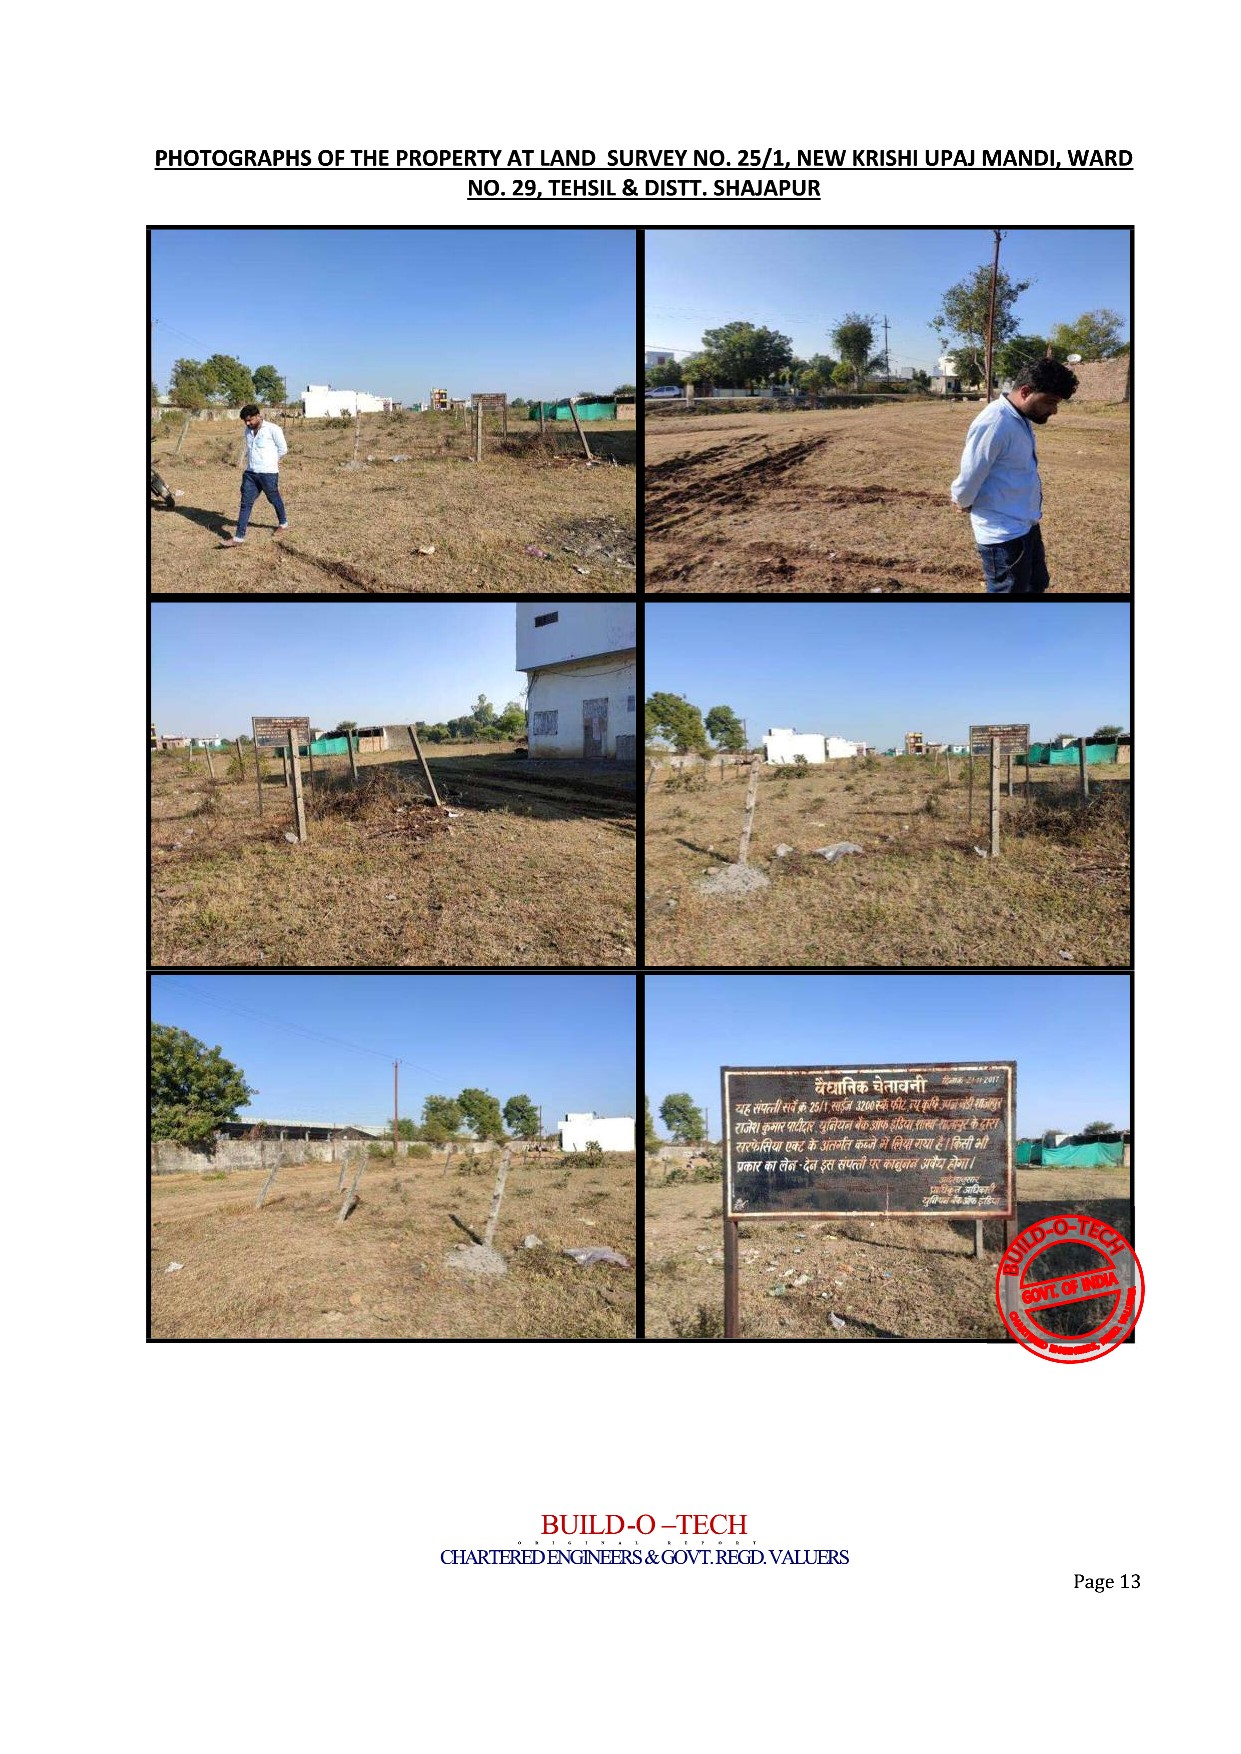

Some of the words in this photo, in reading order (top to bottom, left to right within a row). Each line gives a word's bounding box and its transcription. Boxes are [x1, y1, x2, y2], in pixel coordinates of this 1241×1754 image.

[155, 149, 312, 167] PHOTOGRAPHS
[317, 149, 345, 167] OF
[350, 149, 390, 167] THE
[396, 149, 503, 167] PROPERTY
[506, 149, 535, 167] AT
[540, 149, 596, 167] LAND
[607, 149, 688, 167] SURVEY
[693, 149, 731, 167] NO.
[737, 148, 791, 169] 25/1,
[797, 149, 847, 167] NEW
[852, 149, 918, 167] KRISHI
[925, 149, 975, 167] UPAJ
[982, 149, 1062, 169] MANDI,
[1067, 149, 1133, 167] WARD
[468, 179, 506, 197] NO.
[512, 179, 543, 199] 29,
[547, 179, 617, 197] TEHSIL
[621, 178, 639, 197] &
[645, 179, 707, 197] DISTT.
[713, 179, 821, 197] SHAJAPUR
[873, 1074, 928, 1094] चेतावनी
[735, 1103, 751, 1116] यह
[856, 1100, 875, 1111] 3200
[735, 1120, 760, 1135] राजेश
[762, 1121, 786, 1136] कुमार
[807, 1138, 819, 1150] के
[914, 1138, 934, 1150] गया
[974, 1135, 989, 1150] भी
[737, 1160, 763, 1173] प्रकार
[764, 1160, 778, 1172] का
[820, 1159, 835, 1173] इस
[869, 1159, 882, 1170] पर
[440, 1549, 545, 1565] CHARTERED
[547, 1549, 643, 1565] ENGINEERS
[645, 1549, 660, 1565] &
[661, 1549, 714, 1565] GOVT.
[716, 1549, 767, 1565] REGD.
[768, 1549, 850, 1565] VALUERS
[1073, 1573, 1115, 1594] Page
[1120, 1573, 1141, 1589] 13
